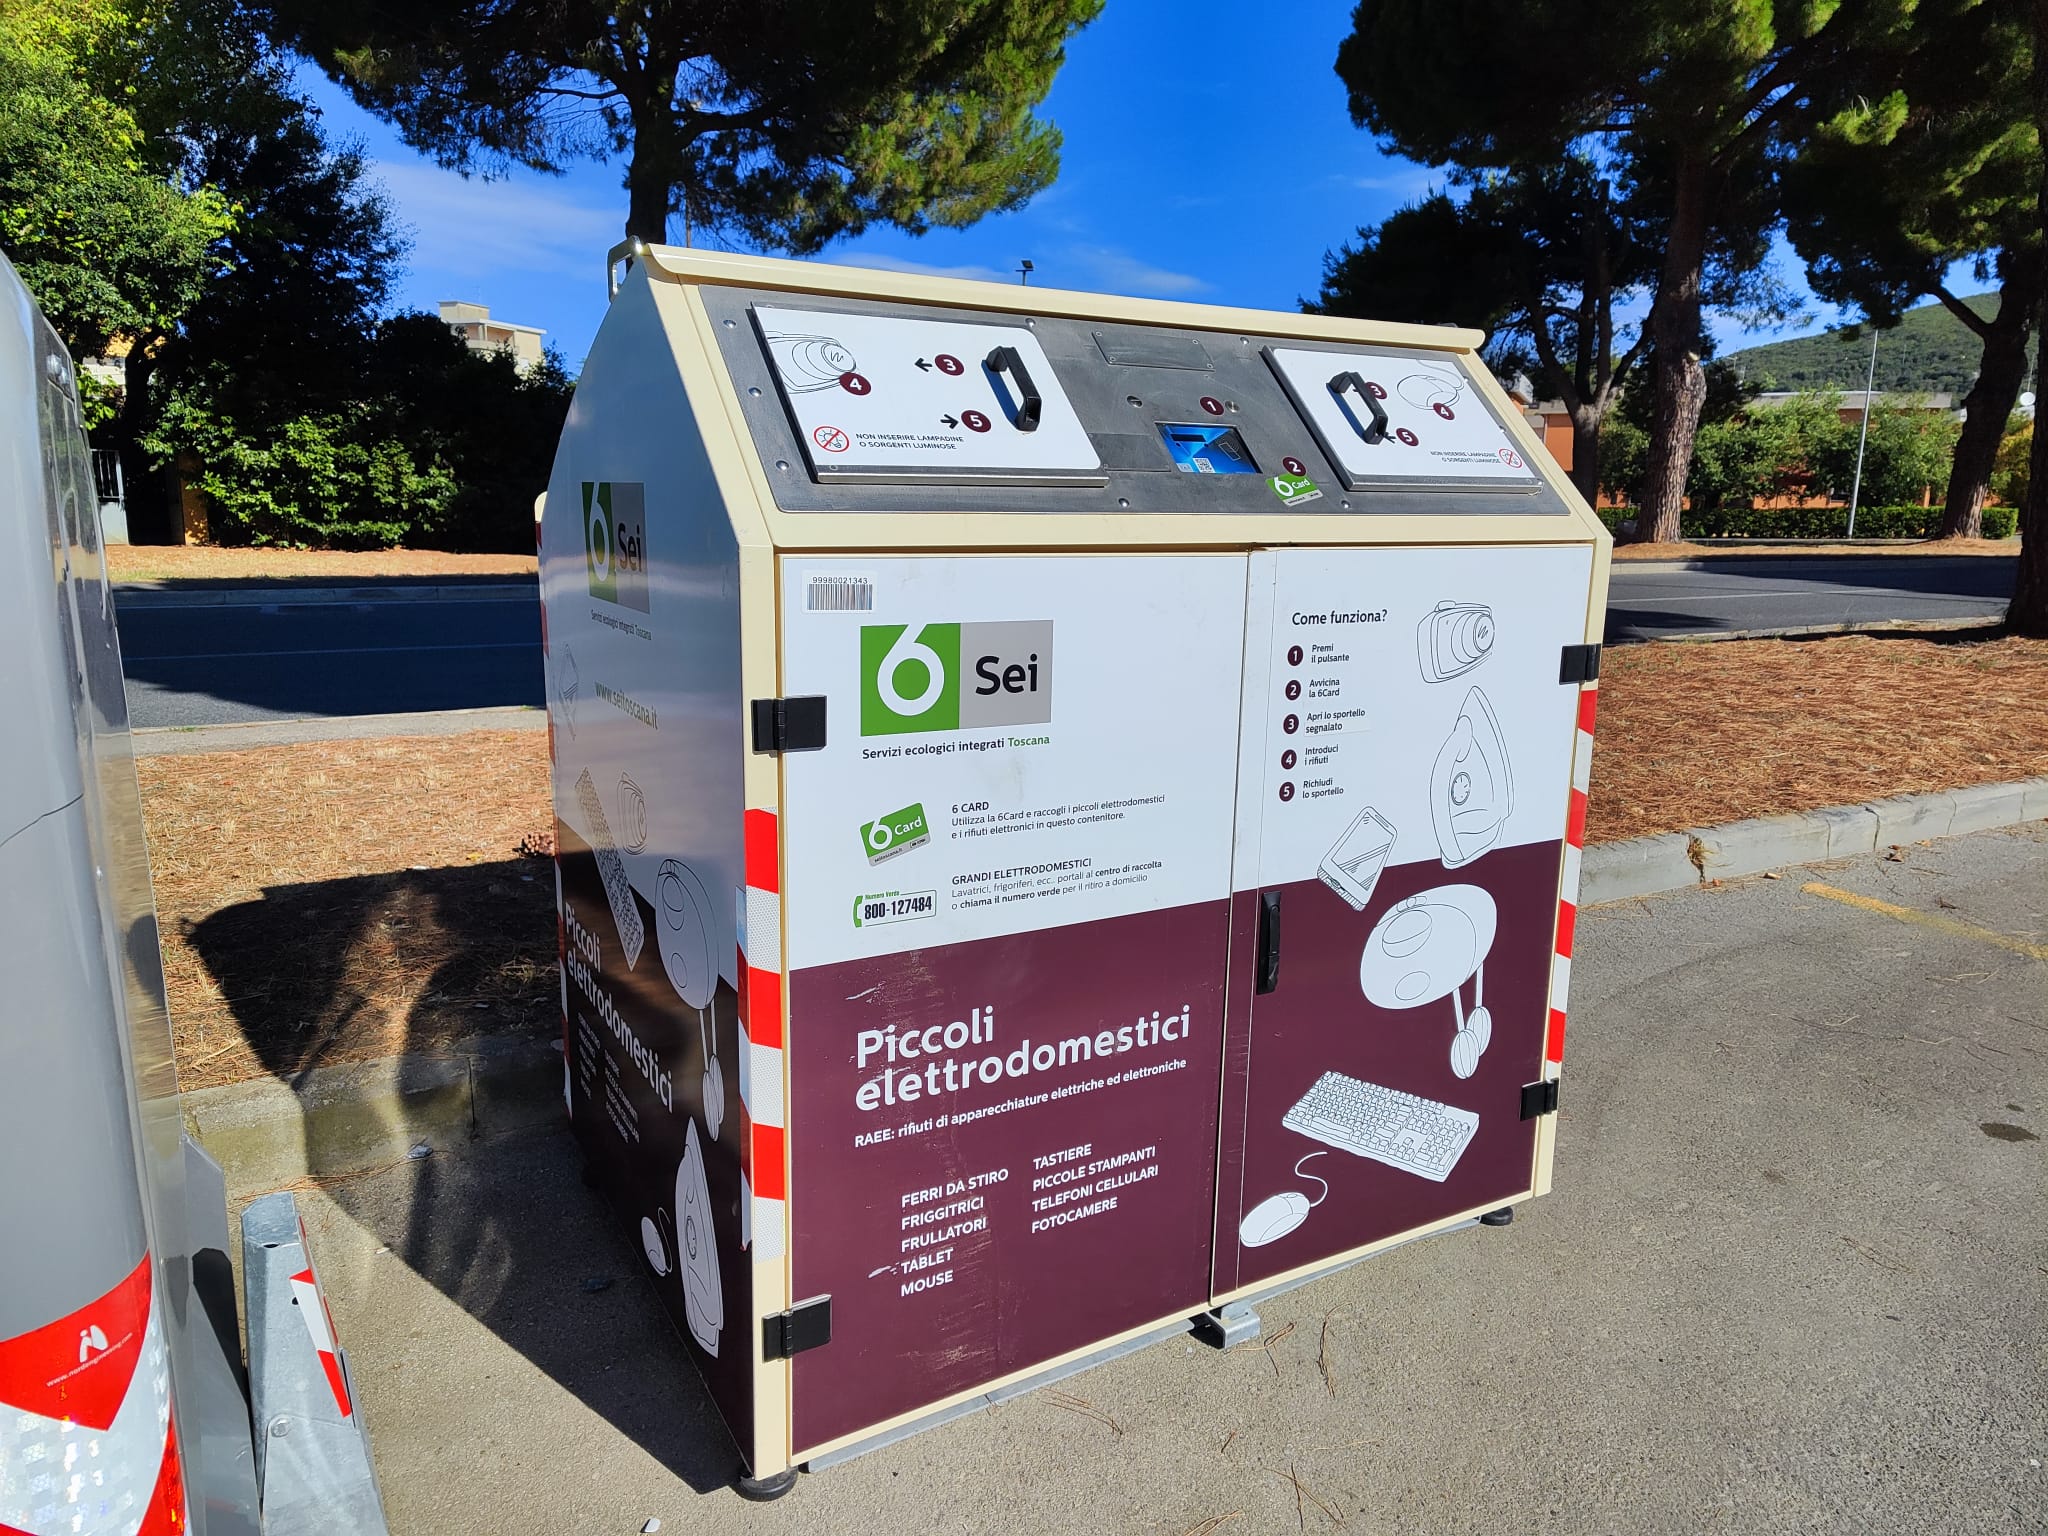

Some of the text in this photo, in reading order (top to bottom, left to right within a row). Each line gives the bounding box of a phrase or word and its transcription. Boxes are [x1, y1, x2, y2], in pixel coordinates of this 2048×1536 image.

[944, 359, 956, 371] 3
[850, 377, 862, 390] 4
[1207, 401, 1217, 412] 1
[1440, 407, 1450, 417] 4
[970, 414, 983, 428] 5
[1401, 432, 1413, 443] 5
[914, 442, 957, 450] LUMINOSE
[1289, 461, 1302, 473] 2
[588, 481, 642, 582] 6 Sei
[812, 576, 868, 585] 99980021343
[1292, 609, 1388, 625] Come funziona?
[1312, 643, 1334, 653] Premi
[1311, 654, 1350, 664] il pulsante
[877, 624, 1038, 716] 6 Sei
[1290, 684, 1297, 696] 2
[1309, 678, 1340, 688] Avvicina
[1309, 688, 1340, 698] la 6Card
[1307, 708, 1366, 722] Apri lo sportello
[1288, 718, 1295, 730] 3
[1306, 723, 1343, 734] segnalato
[862, 735, 1050, 760] Servizi ecologici integrati Toscana
[1305, 744, 1339, 756] Introduci
[1286, 754, 1292, 765] 4
[1309, 755, 1329, 766] rifiuti
[1303, 778, 1333, 788] Richiudi
[1284, 786, 1290, 798] 5
[1303, 787, 1344, 799] lo sportello
[952, 802, 989, 814] 6 CARD
[952, 816, 985, 826] Utilizza
[988, 814, 996, 822] la
[998, 810, 1024, 821] 6Card
[1033, 806, 1066, 817] raccogli
[1072, 802, 1099, 814] piccoli
[1100, 794, 1165, 810] elettrodomestici
[894, 816, 922, 836] Card
[964, 826, 988, 838] rifiuti
[990, 822, 1034, 835] elettronici
[1036, 820, 1044, 830] in
[1046, 818, 1076, 830] questo
[1077, 812, 1126, 824] contenitore.
[952, 858, 1092, 885] GRANDI ELETTRODOMESTICI
[952, 886, 992, 898] Lavatrici,
[994, 878, 1034, 892] frigoriferi,
[1058, 872, 1084, 884] portali
[1086, 870, 1094, 879] al
[1095, 867, 1120, 877] centro
[1122, 864, 1130, 872] di
[1132, 860, 1162, 872] raccolta
[960, 898, 992, 908] chiama
[994, 896, 1000, 904] il
[1002, 892, 1035, 903] numero
[1037, 887, 1060, 898] verde
[1062, 886, 1076, 894] per
[1078, 882, 1083, 892] il
[1084, 880, 1104, 890] ritiro
[1112, 874, 1148, 886] domicilio
[864, 896, 932, 920] 800-127484
[565, 902, 601, 973] Piccoli
[567, 950, 673, 1114] elettrodomestici
[857, 1004, 994, 1069] Piccoli
[855, 1004, 1191, 1112] elettrodomestici
[855, 1058, 1187, 1148] RAEE: rifiuti di apparecchiature elettriche ed elettroniche
[1033, 1144, 1092, 1170] TASTIERE
[1032, 1146, 1156, 1192] PICCOLE STAMPANTI
[902, 1168, 1009, 1209] FERRI DA STIRO
[1032, 1165, 1159, 1213] TELEFONI CELLULARI
[901, 1196, 984, 1231] FRIGGITRICI
[1032, 1196, 1118, 1234] FOTOCAMERE
[901, 1217, 987, 1253] FRULLATORI
[901, 1247, 954, 1275] TABLET
[901, 1270, 954, 1297] MOUSE
